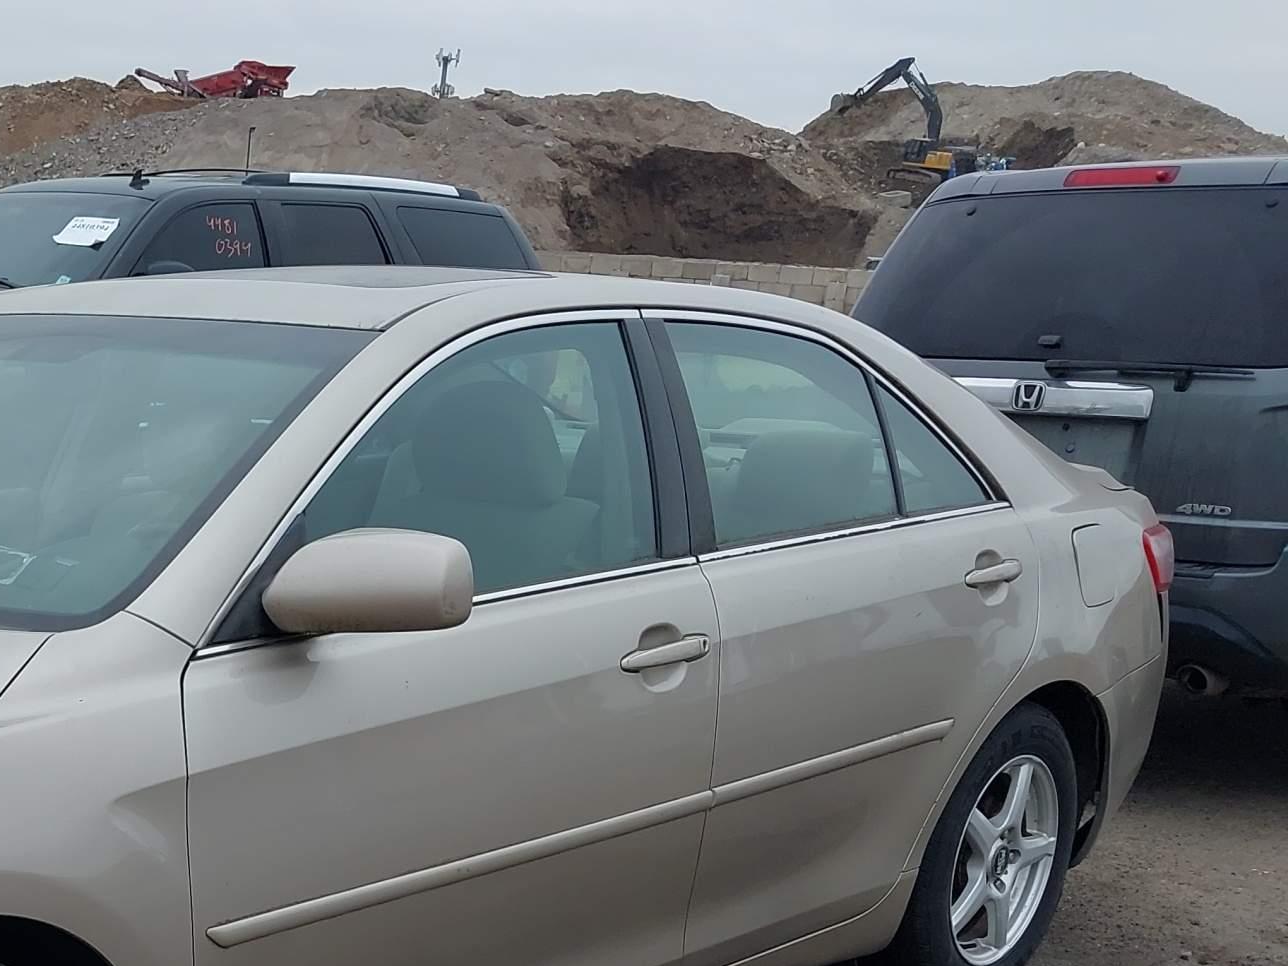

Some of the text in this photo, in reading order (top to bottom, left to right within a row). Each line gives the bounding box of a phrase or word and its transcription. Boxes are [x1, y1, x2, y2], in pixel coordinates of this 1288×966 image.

[206, 215, 237, 235] 4481
[216, 238, 251, 258] 0394
[1175, 503, 1232, 516] 4WD
